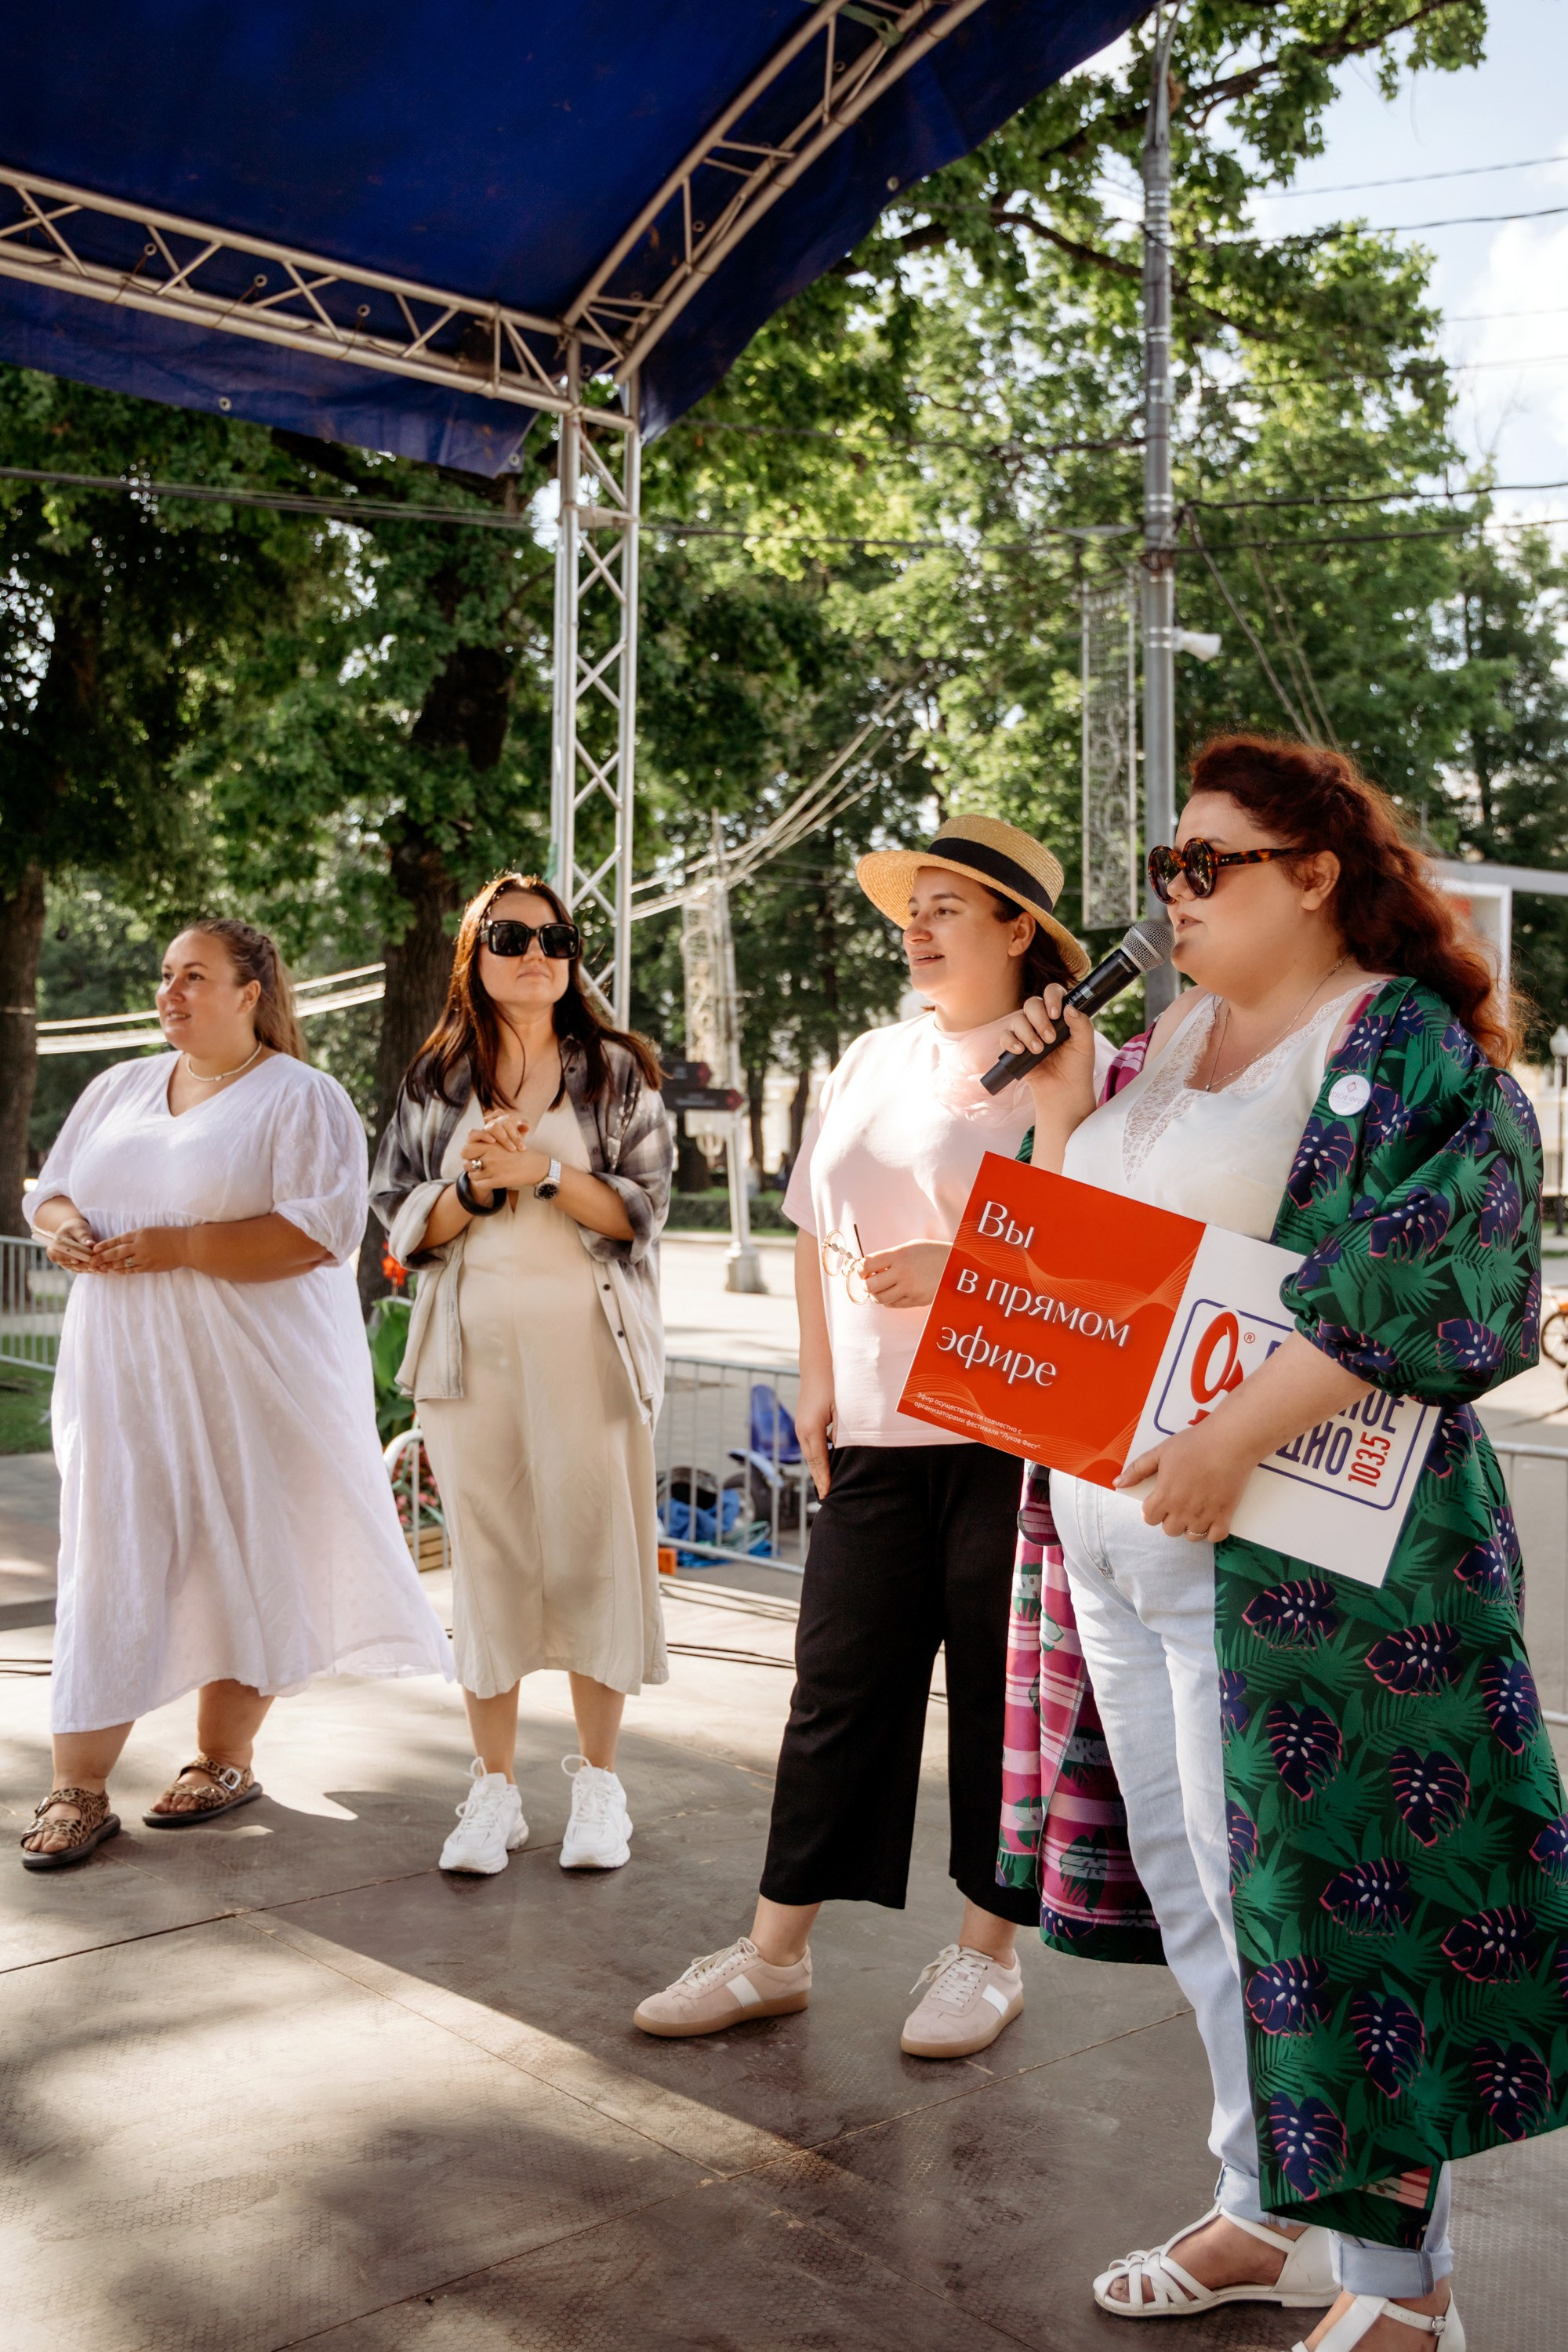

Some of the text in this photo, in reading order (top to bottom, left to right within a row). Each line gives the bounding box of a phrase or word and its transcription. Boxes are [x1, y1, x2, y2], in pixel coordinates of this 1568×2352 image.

[978, 1200, 1034, 1249] Вы
[956, 1269, 1130, 1348] в прямом
[936, 1326, 1058, 1386] эфире
[913, 1401, 966, 1424] организаторами
[965, 1419, 999, 1436] фестиваля
[916, 1392, 935, 1403] Эфир
[935, 1399, 984, 1421] осуществляется
[984, 1417, 1018, 1433] совместно
[1347, 1432, 1391, 1487] 103.5
